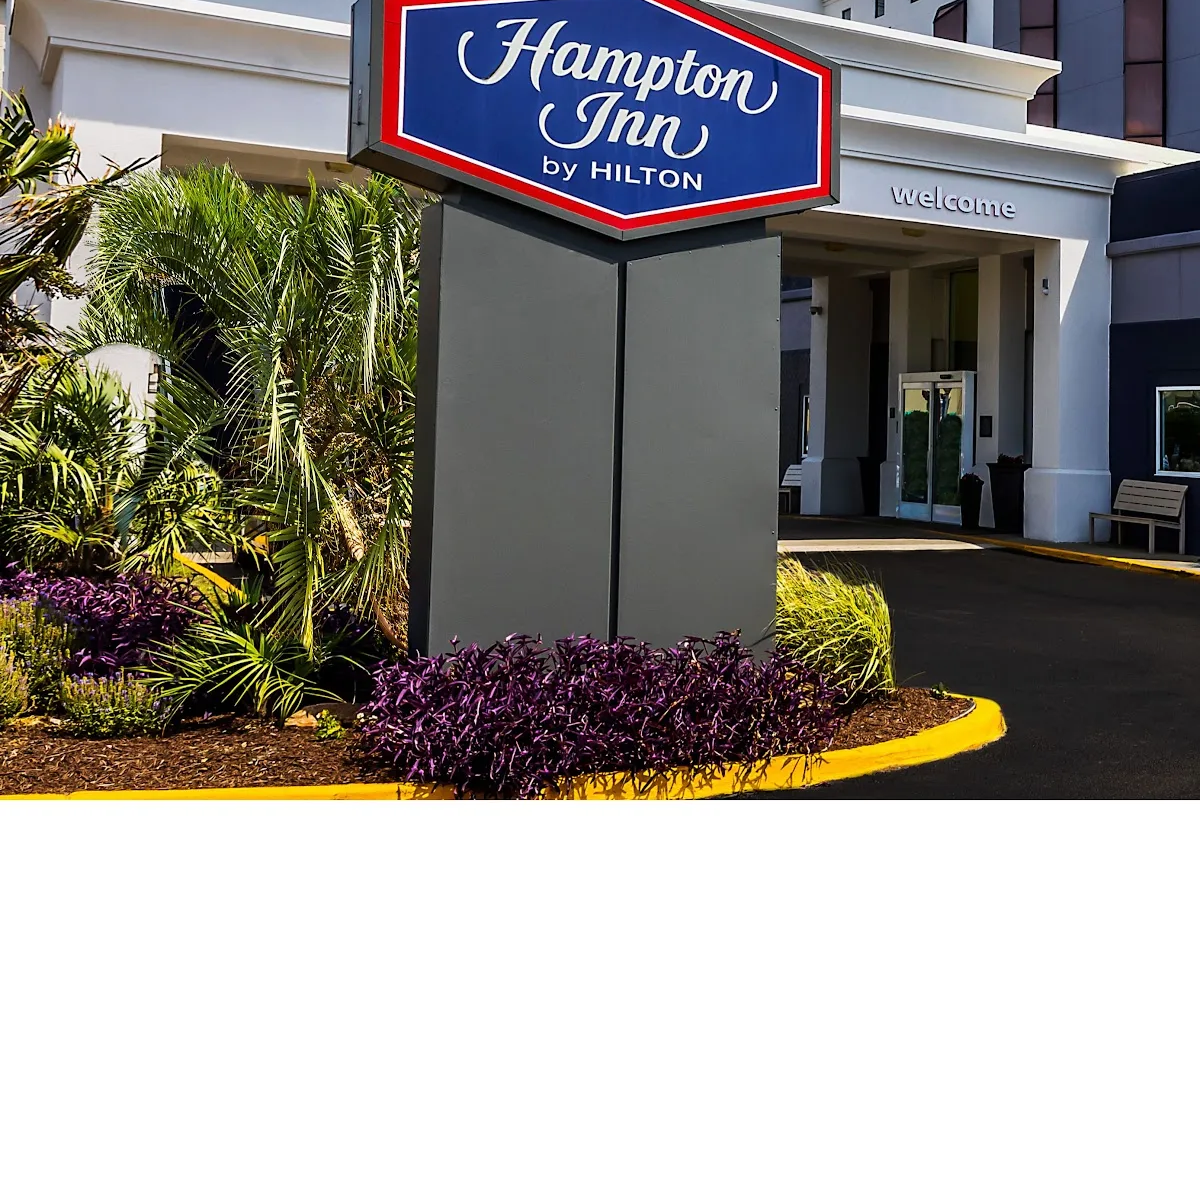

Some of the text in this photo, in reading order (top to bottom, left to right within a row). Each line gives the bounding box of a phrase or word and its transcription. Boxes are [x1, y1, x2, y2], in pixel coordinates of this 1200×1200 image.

[458, 18, 778, 115] Hampton
[539, 92, 709, 160] Inn
[543, 155, 703, 191] by HILTON
[891, 185, 1017, 219] welcome
